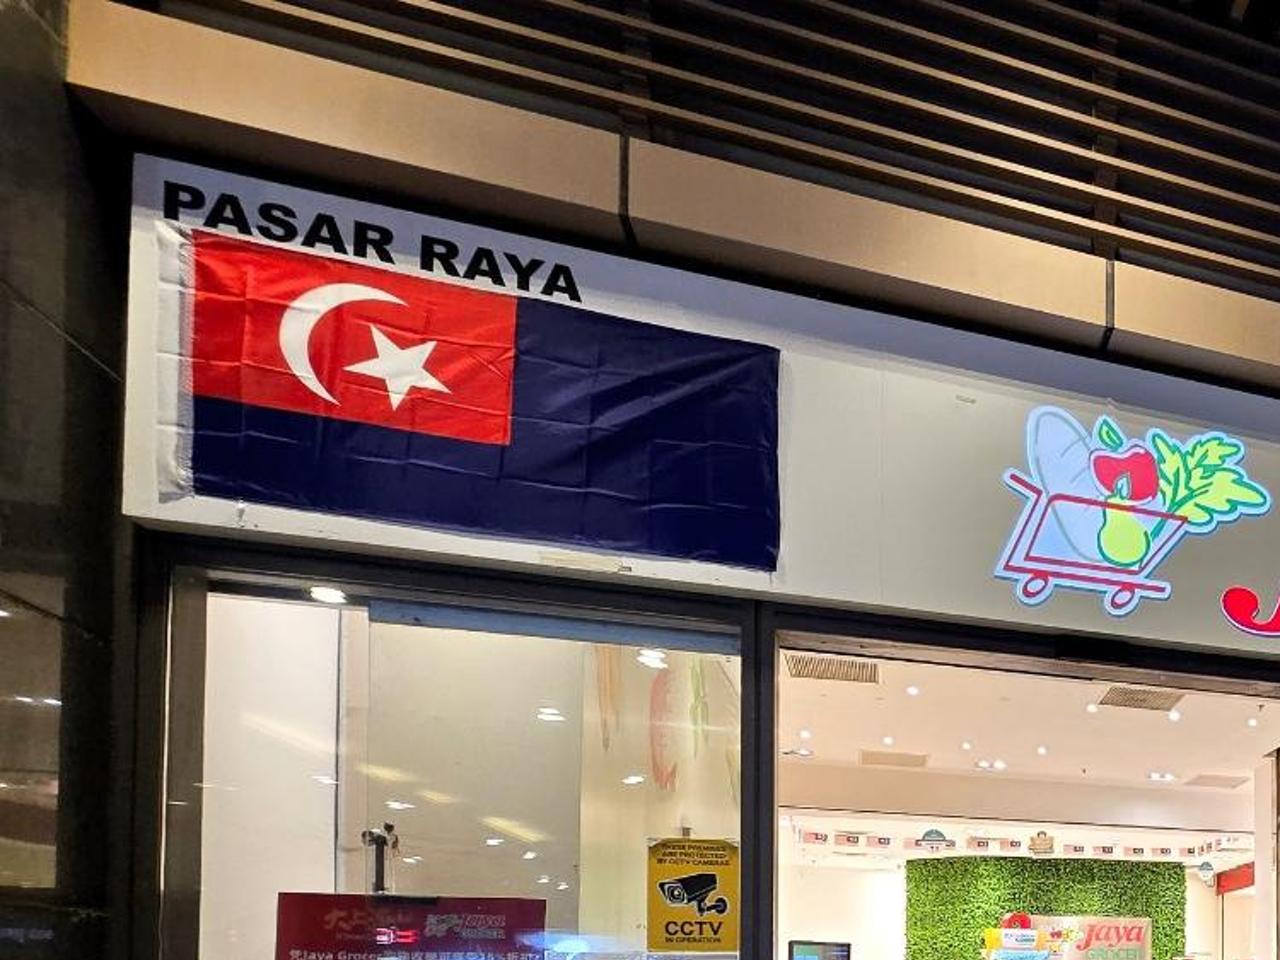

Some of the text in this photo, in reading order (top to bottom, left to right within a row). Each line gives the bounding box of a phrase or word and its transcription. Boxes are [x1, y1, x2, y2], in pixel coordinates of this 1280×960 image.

[163, 180, 583, 303] PASAR RAYA
[664, 920, 724, 937] CCTV
[1076, 923, 1144, 951] Jaya
